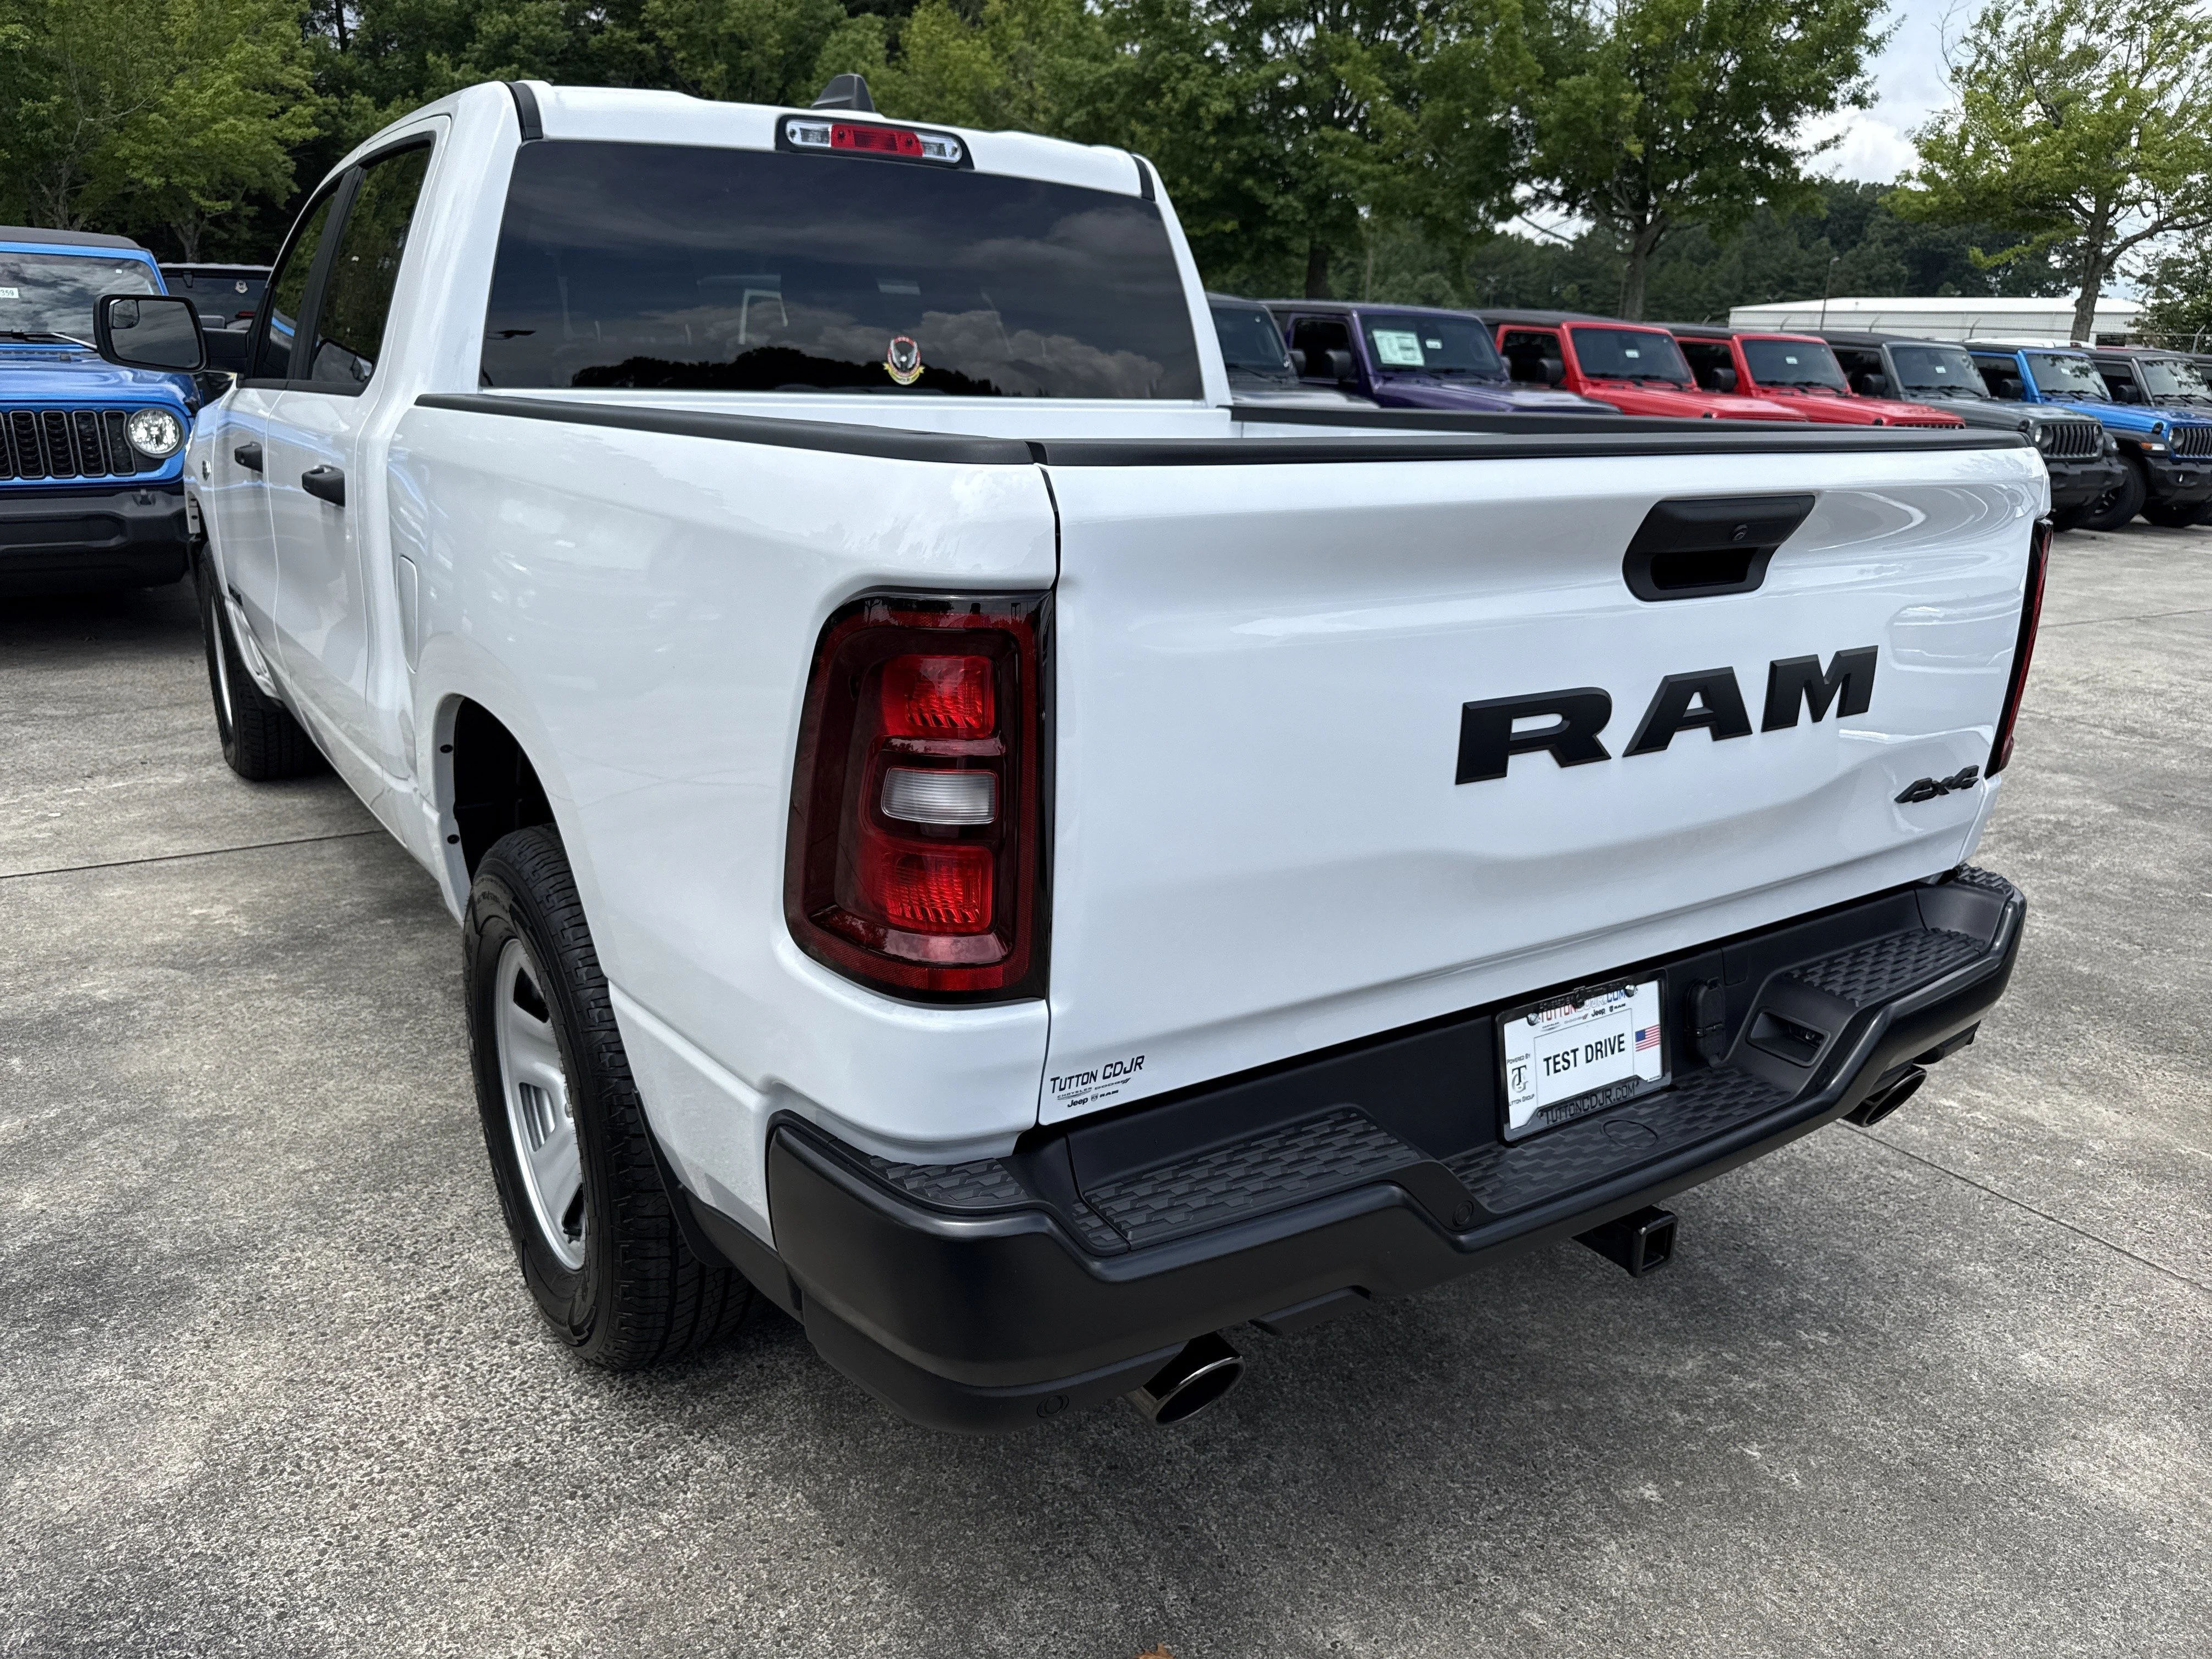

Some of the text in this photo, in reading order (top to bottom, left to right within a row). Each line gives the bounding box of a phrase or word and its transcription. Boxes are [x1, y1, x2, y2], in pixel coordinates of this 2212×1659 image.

[1455, 645, 1878, 784] RAM
[1591, 1008, 1606, 1017] Jeep
[1543, 1032, 1626, 1076] TEST DRIVE
[1050, 1055, 1145, 1094] TUTTON CDJR
[1057, 1087, 1092, 1098] CHRYSLER
[1067, 1090, 1119, 1108] Jeep RAM
[1508, 1098, 1522, 1107] UTTON
[1544, 1081, 1635, 1125] TUTTONCDJR.COM
